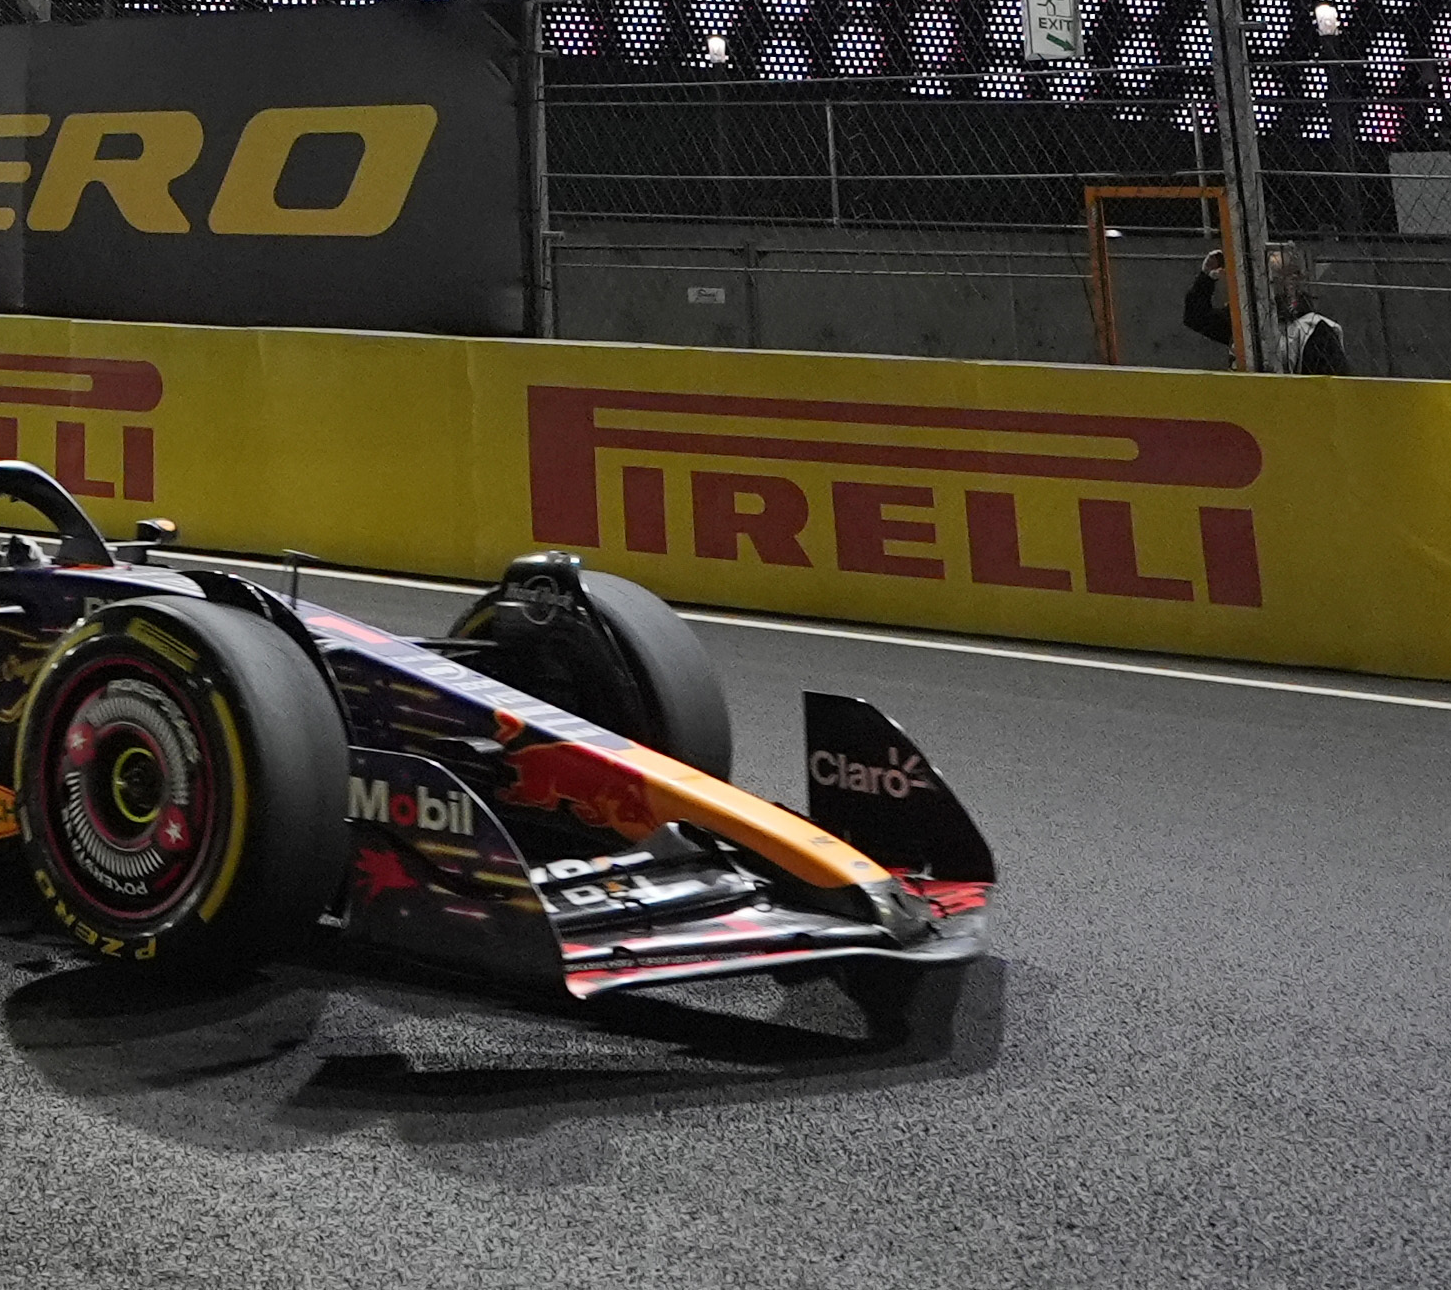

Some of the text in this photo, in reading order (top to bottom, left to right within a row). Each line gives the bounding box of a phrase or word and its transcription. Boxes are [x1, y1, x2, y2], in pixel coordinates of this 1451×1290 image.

[1038, 17, 1073, 32] EXIT
[527, 385, 1263, 608] PIRELLI
[811, 749, 909, 800] Claro
[347, 776, 474, 836] Mobil
